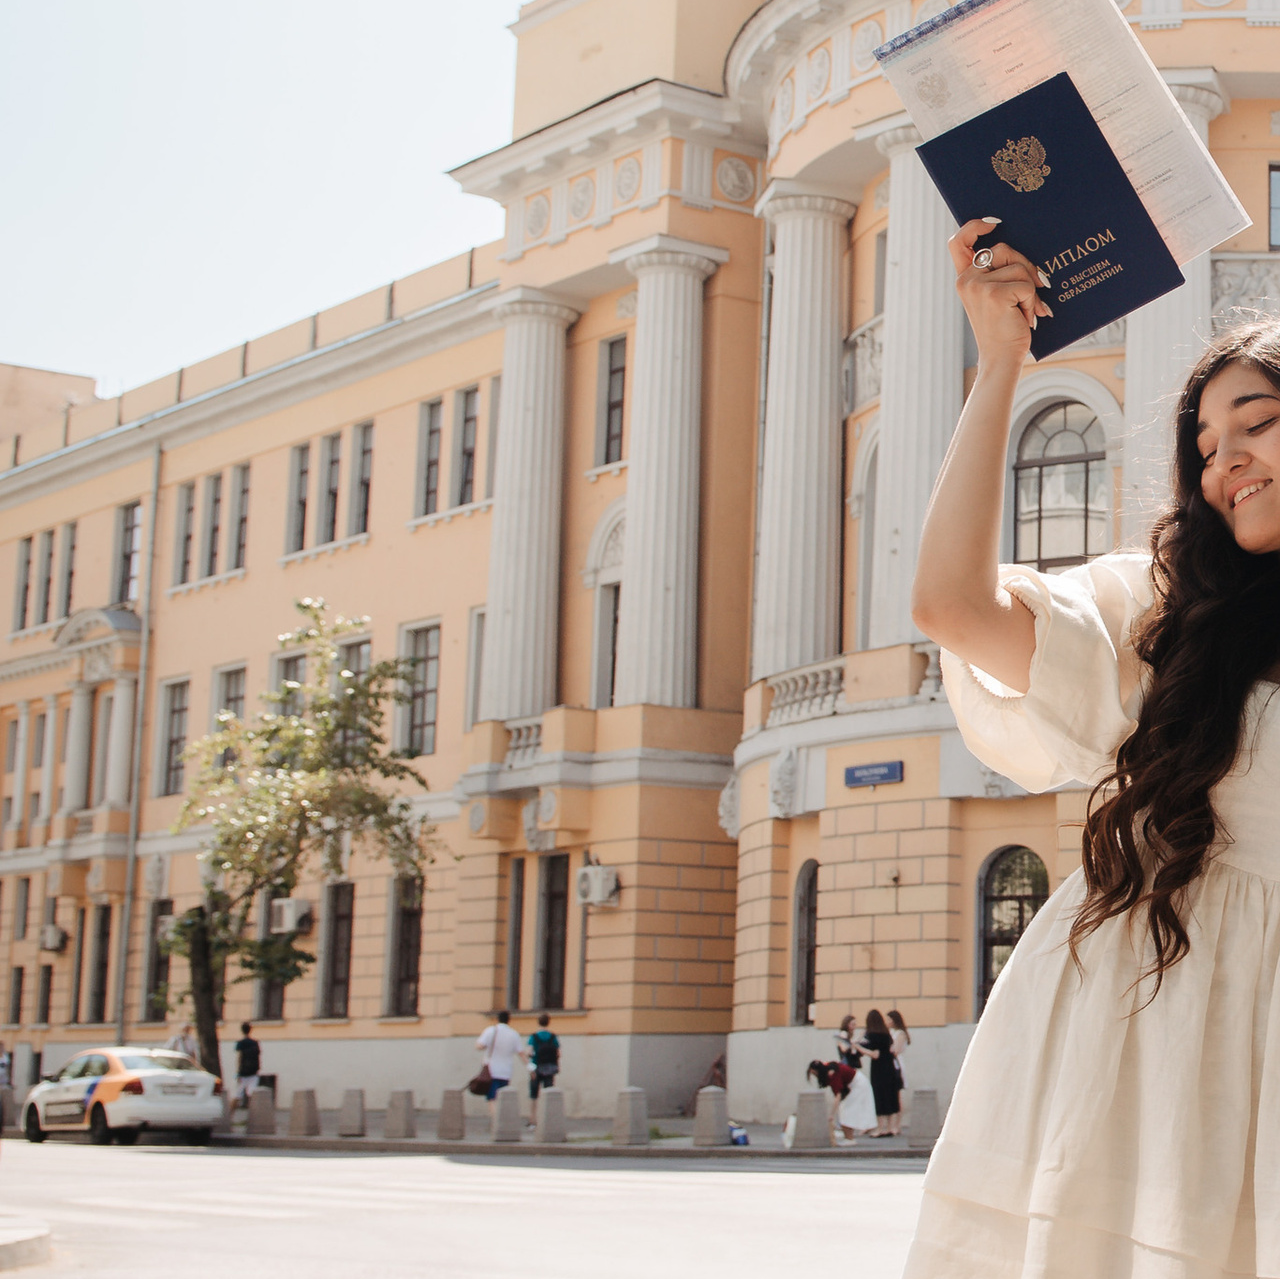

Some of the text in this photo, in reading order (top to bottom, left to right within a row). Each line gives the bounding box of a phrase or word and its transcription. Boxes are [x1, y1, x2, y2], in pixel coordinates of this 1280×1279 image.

[1058, 263, 1124, 303] ОБРАЗОВАНИИ
[1061, 258, 1111, 289] О ВЫСШЕМ
